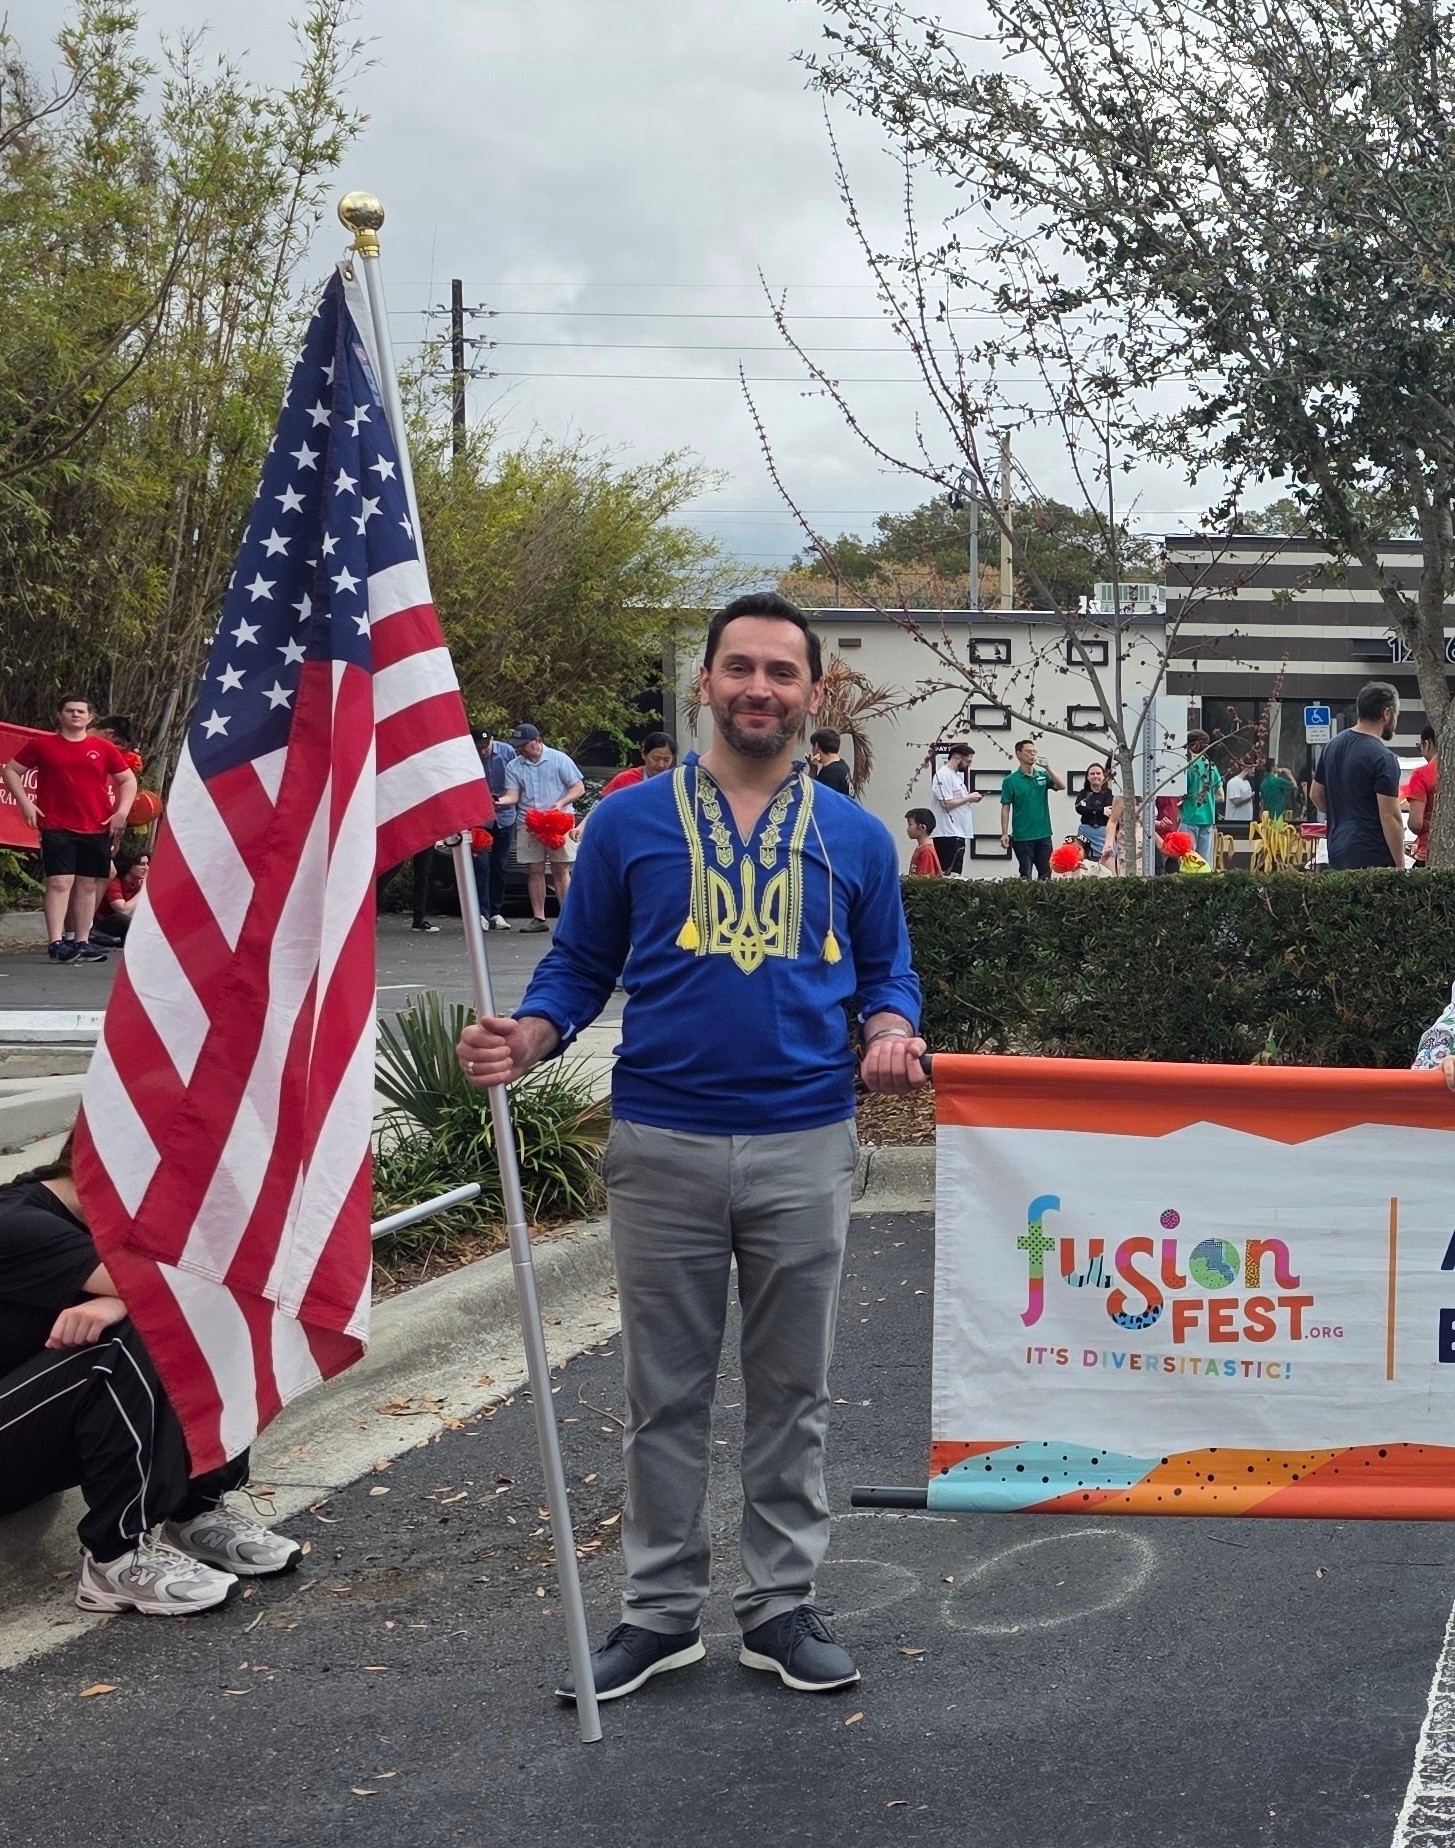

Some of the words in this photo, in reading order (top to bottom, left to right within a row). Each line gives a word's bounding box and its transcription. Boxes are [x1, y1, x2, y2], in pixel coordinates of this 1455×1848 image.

[1017, 1194, 1301, 1330] fusion
[1026, 1347, 1069, 1366] IT'S
[1082, 1349, 1292, 1380] DIVERSITASTIC!
